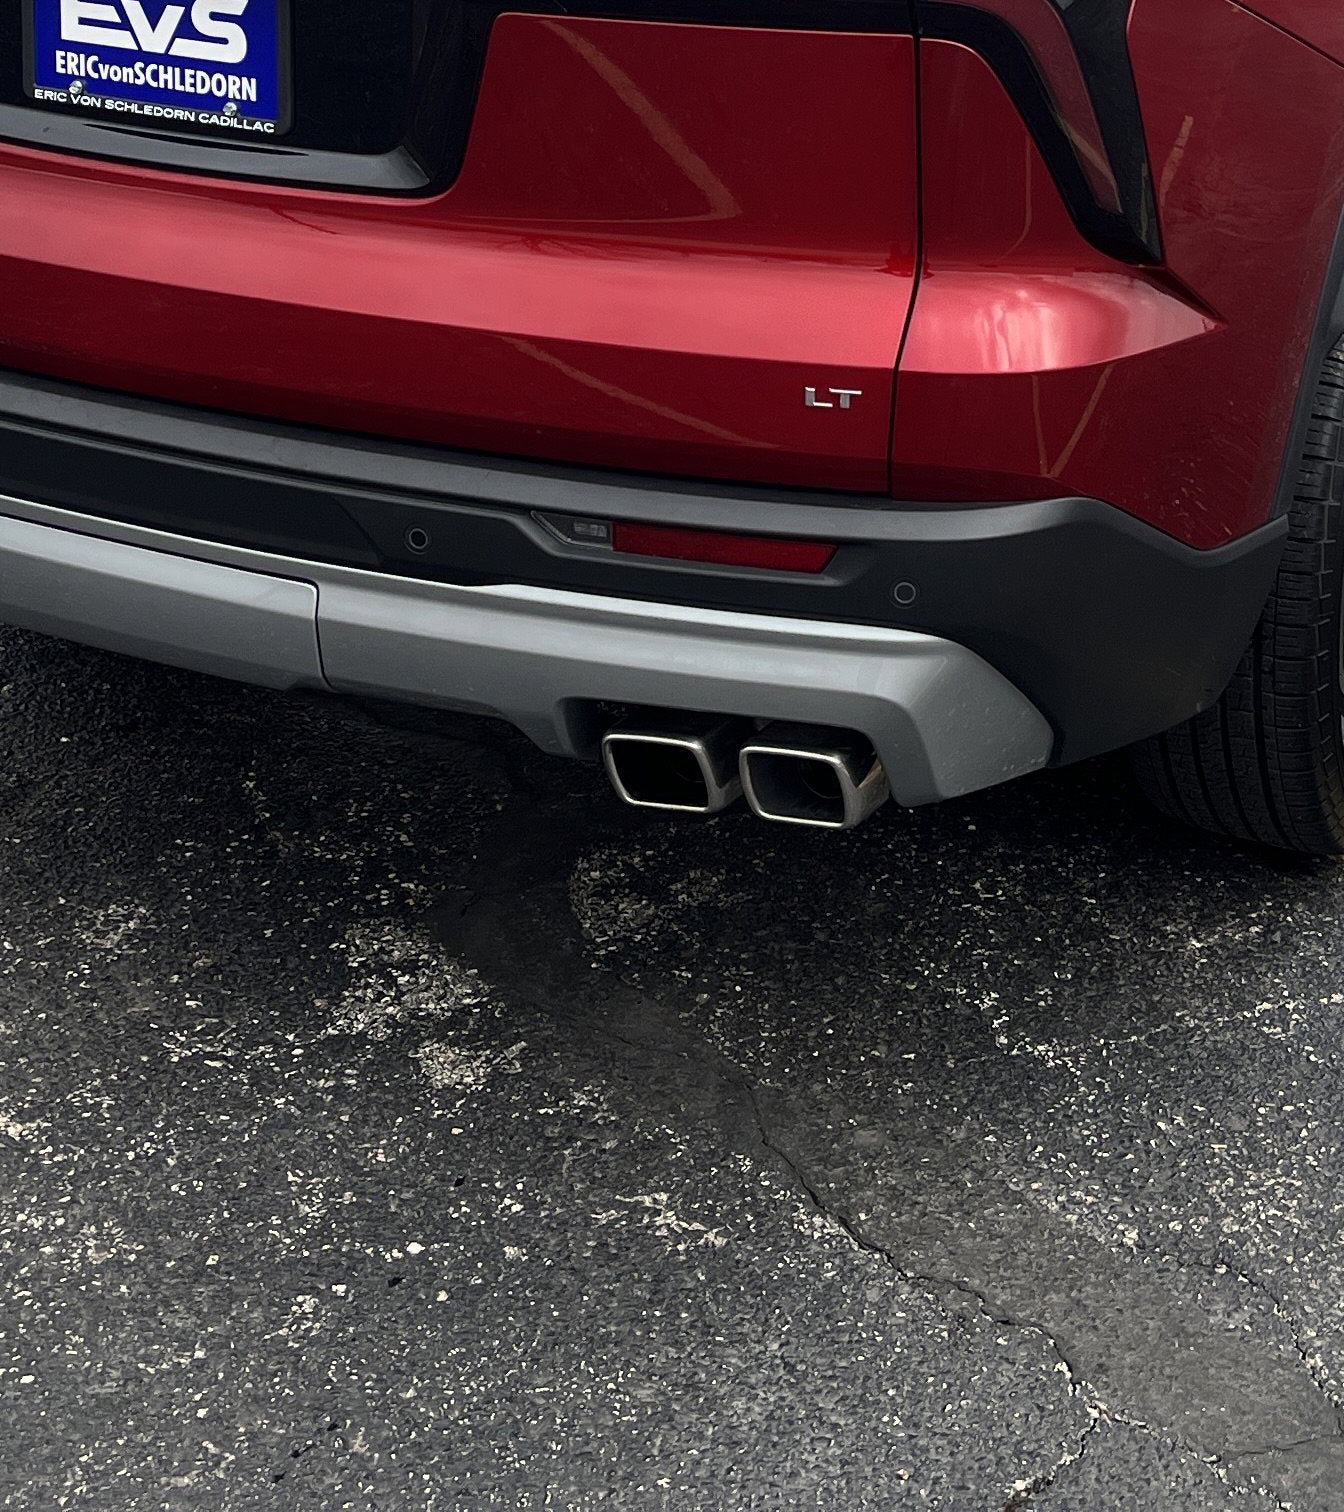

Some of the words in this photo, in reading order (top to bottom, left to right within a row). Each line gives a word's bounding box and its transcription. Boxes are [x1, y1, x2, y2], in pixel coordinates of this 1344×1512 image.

[55, 49, 257, 102] ERICvonSCHLEDORN
[34, 89, 67, 102] ERIC
[70, 94, 102, 108] VON
[104, 99, 196, 121] SCHLEDORN
[198, 113, 275, 133] CADILLAC
[804, 386, 862, 409] LT
